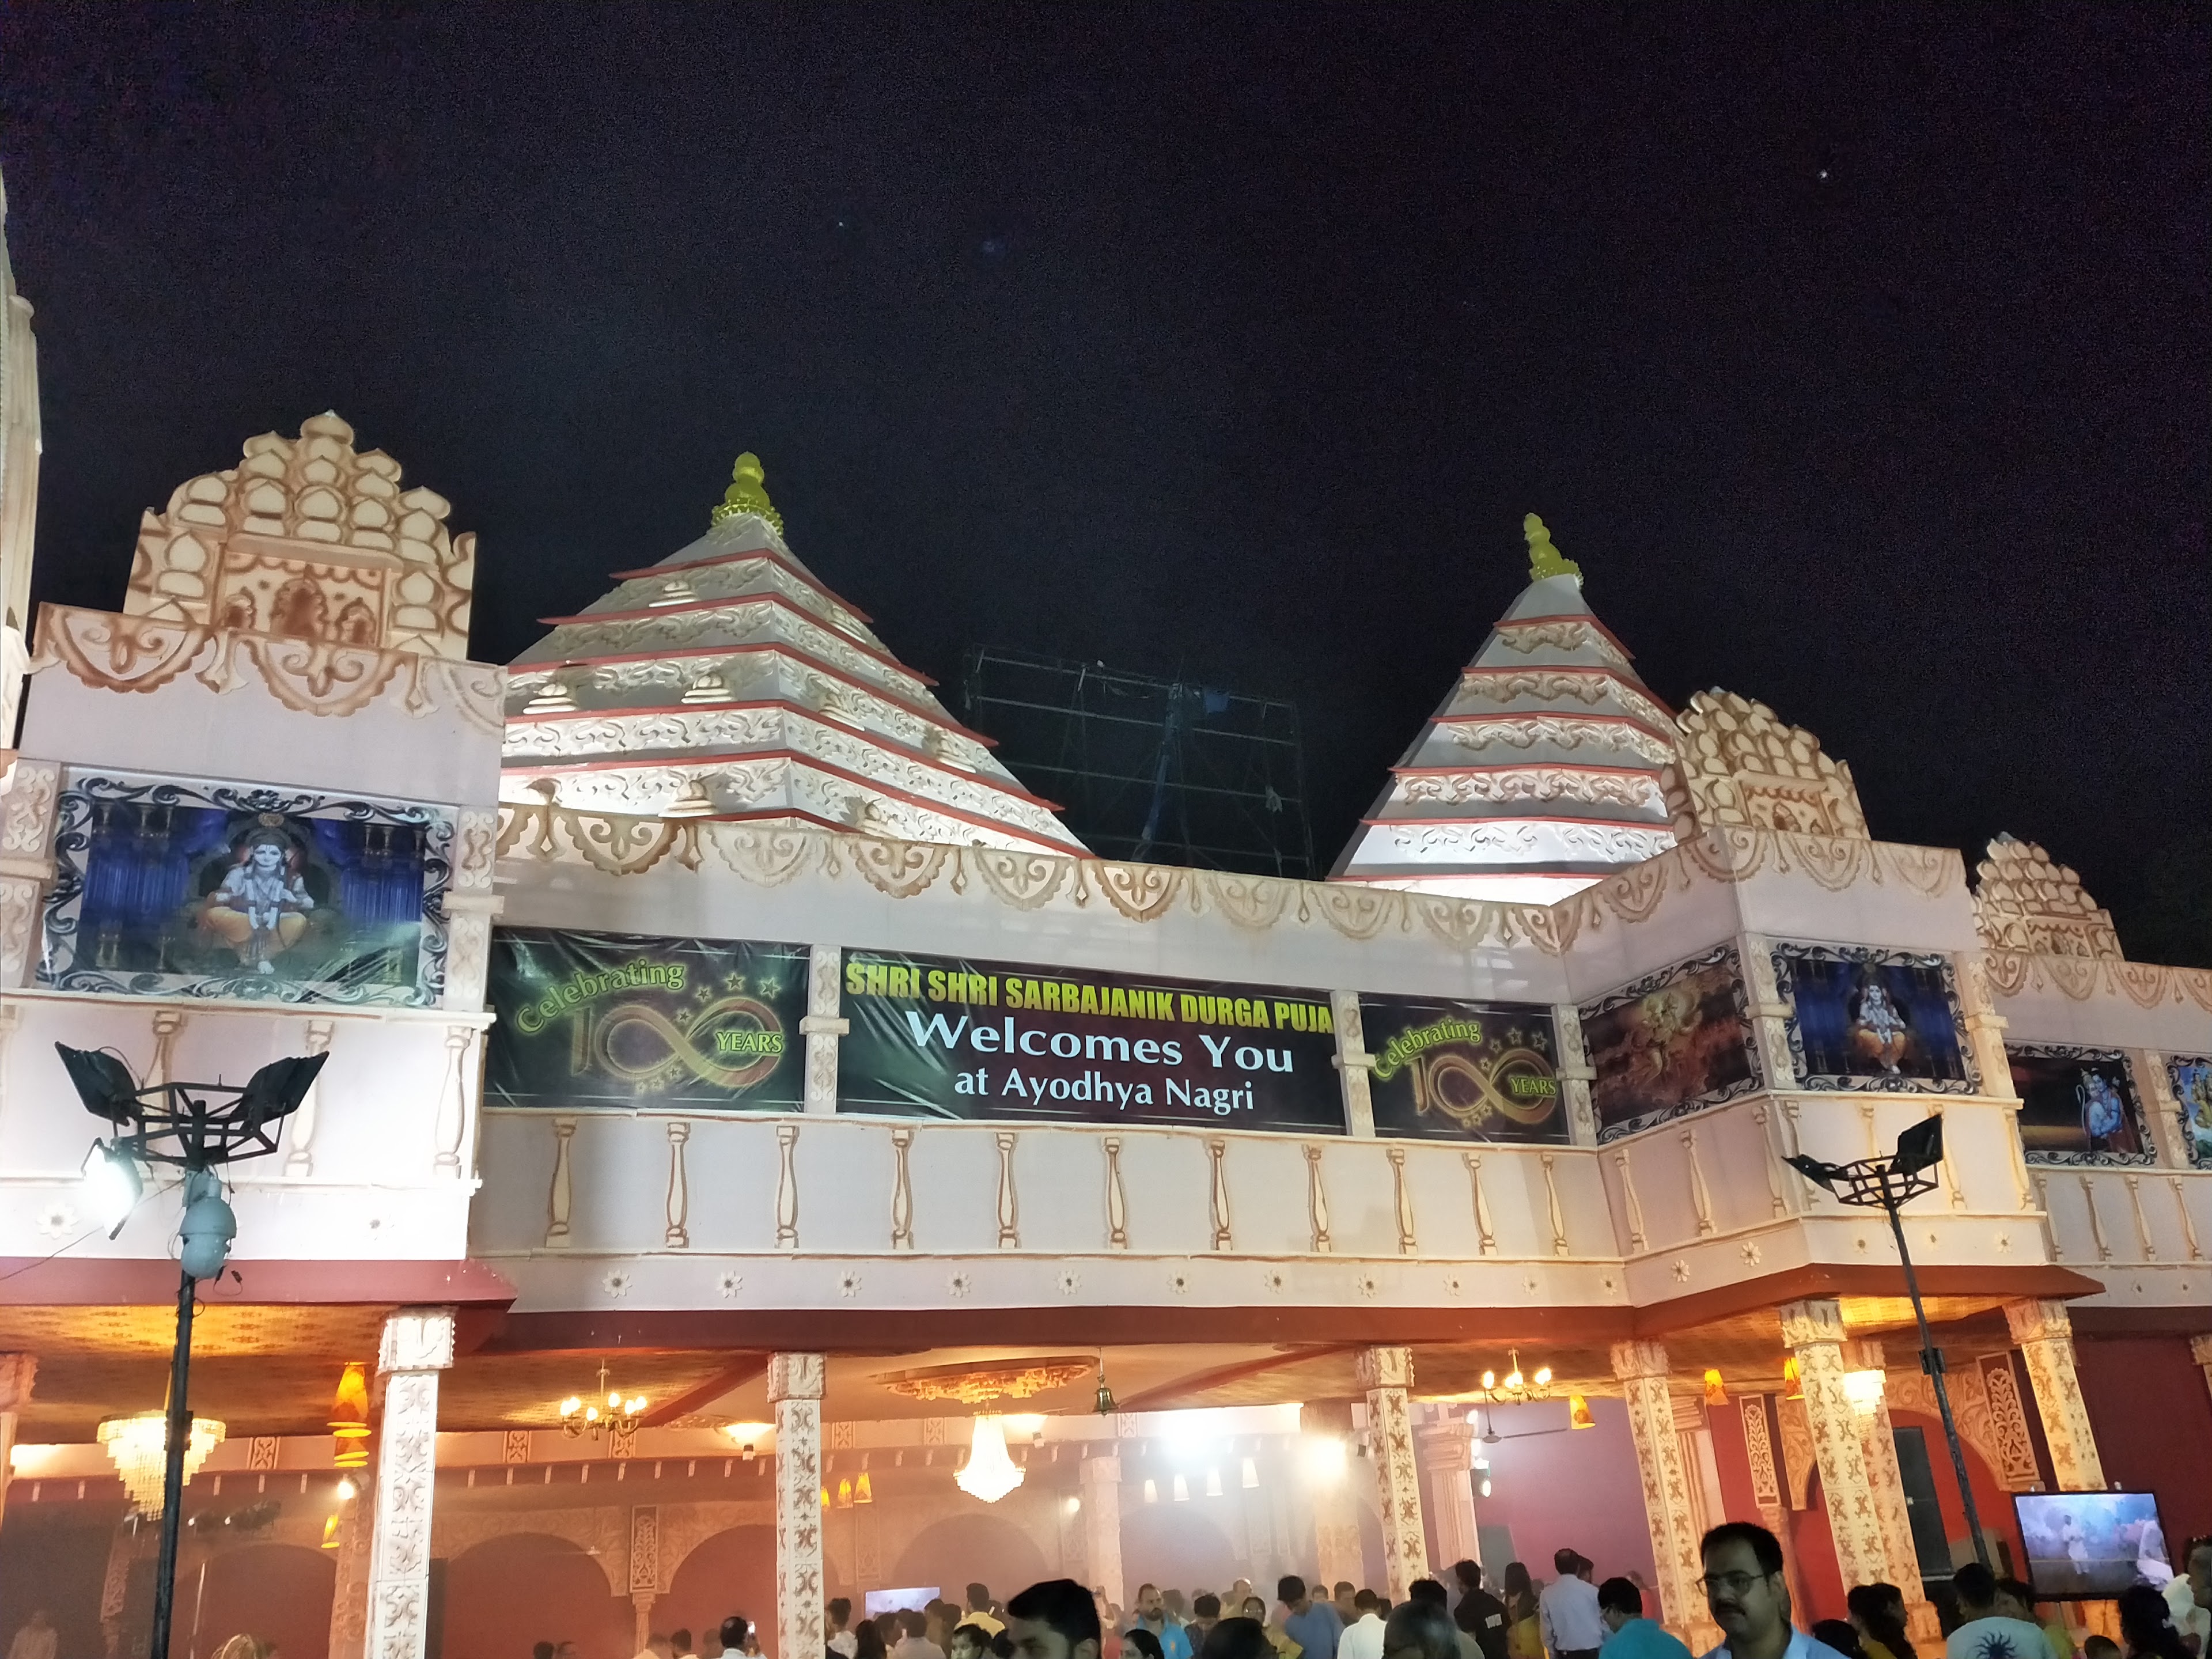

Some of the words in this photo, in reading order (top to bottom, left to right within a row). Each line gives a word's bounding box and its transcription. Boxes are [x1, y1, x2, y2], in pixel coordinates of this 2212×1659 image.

[518, 960, 684, 1033] Celebrating
[846, 963, 920, 999] SHRI
[928, 970, 998, 1006] SHRI
[1006, 977, 1175, 1021] SARBAJANIK
[1180, 994, 1270, 1028] DURGA
[1274, 1001, 1335, 1033] PUJA
[718, 1032, 782, 1053] YEARS
[905, 1011, 1183, 1065] Welcomes
[1198, 1034, 1293, 1072] You
[1374, 1018, 1481, 1078] Celebrating
[954, 1067, 989, 1095] at
[1001, 1067, 1153, 1110] Ayodhya
[1165, 1078, 1253, 1115] Nagri
[1510, 1078, 1556, 1095] YEARS
